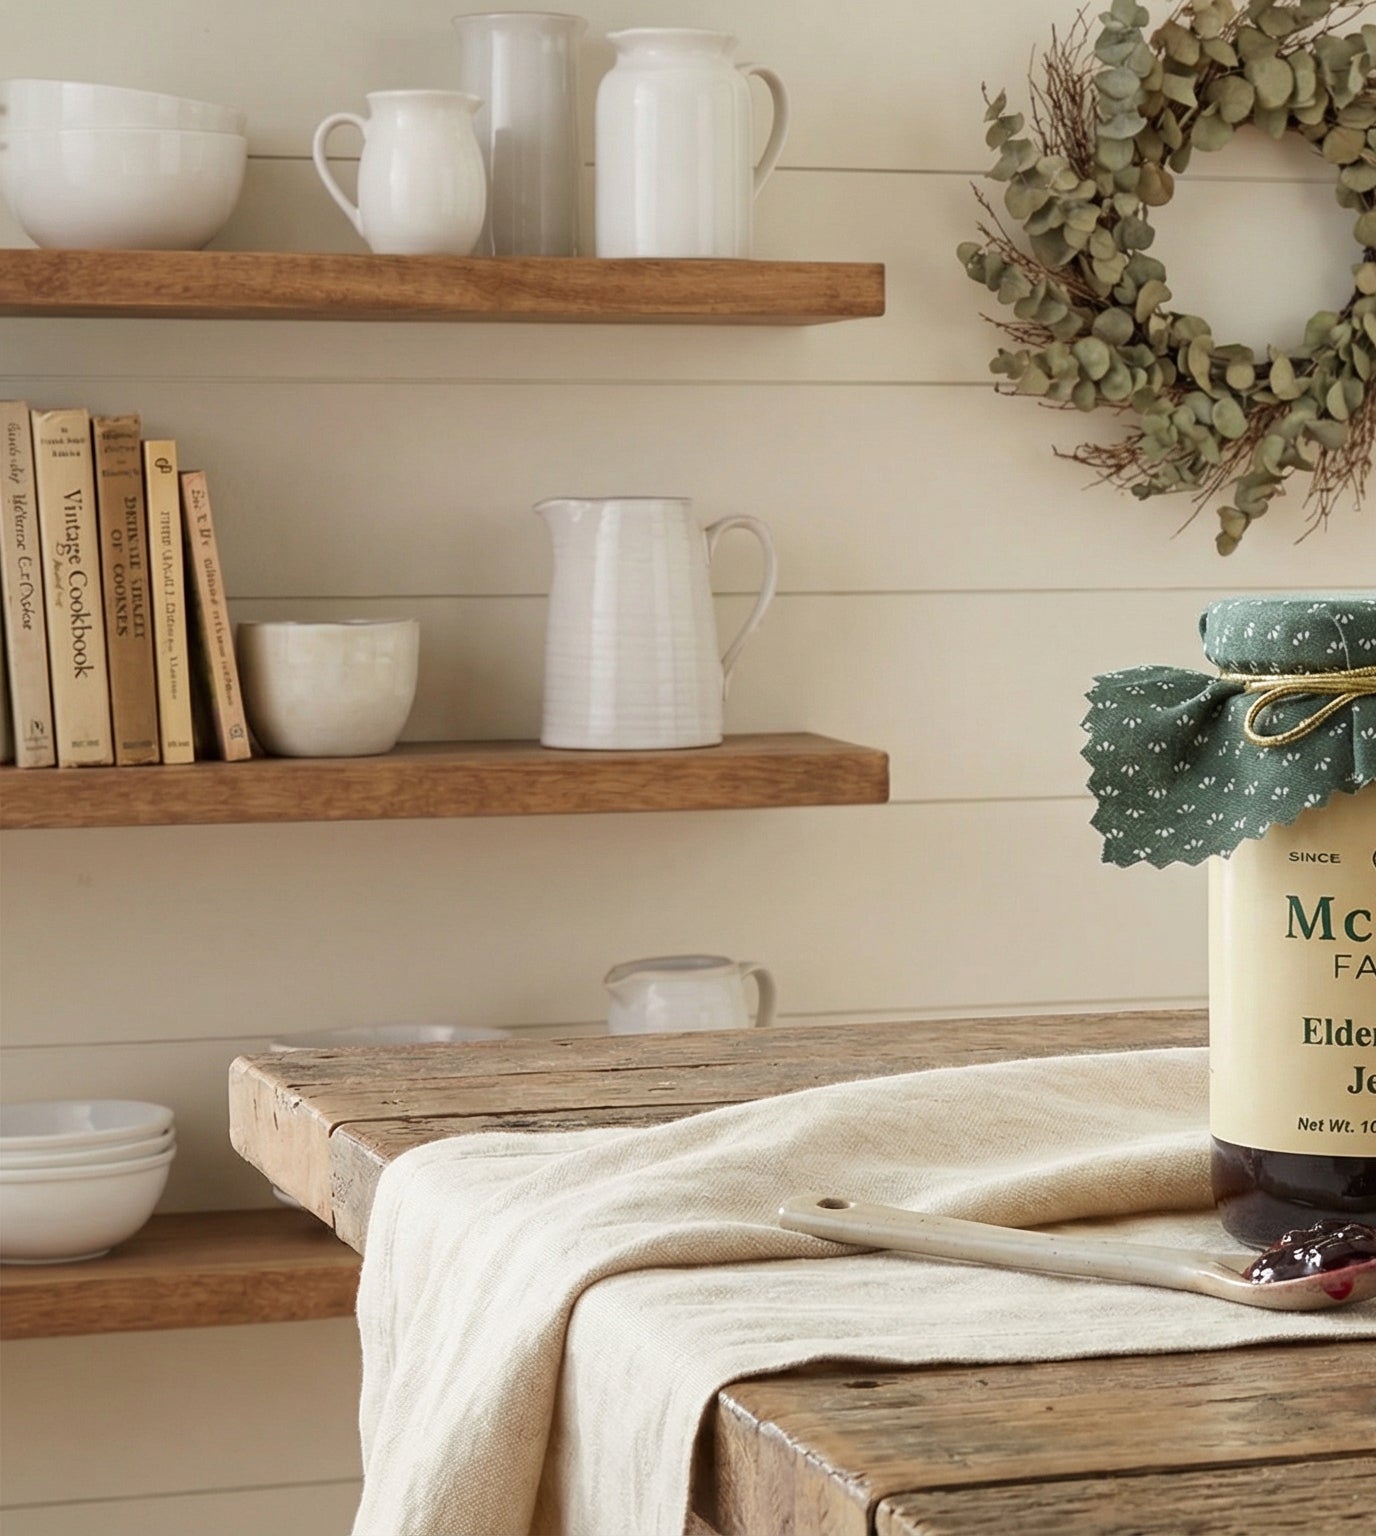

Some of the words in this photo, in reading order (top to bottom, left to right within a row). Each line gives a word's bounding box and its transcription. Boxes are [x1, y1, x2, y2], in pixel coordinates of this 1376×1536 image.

[57, 489, 83, 565] Vintage
[69, 570, 94, 679] Cookbook
[1288, 851, 1342, 864] SINCE
[1298, 1116, 1325, 1132] Net
[1329, 1118, 1355, 1134] Wt.
